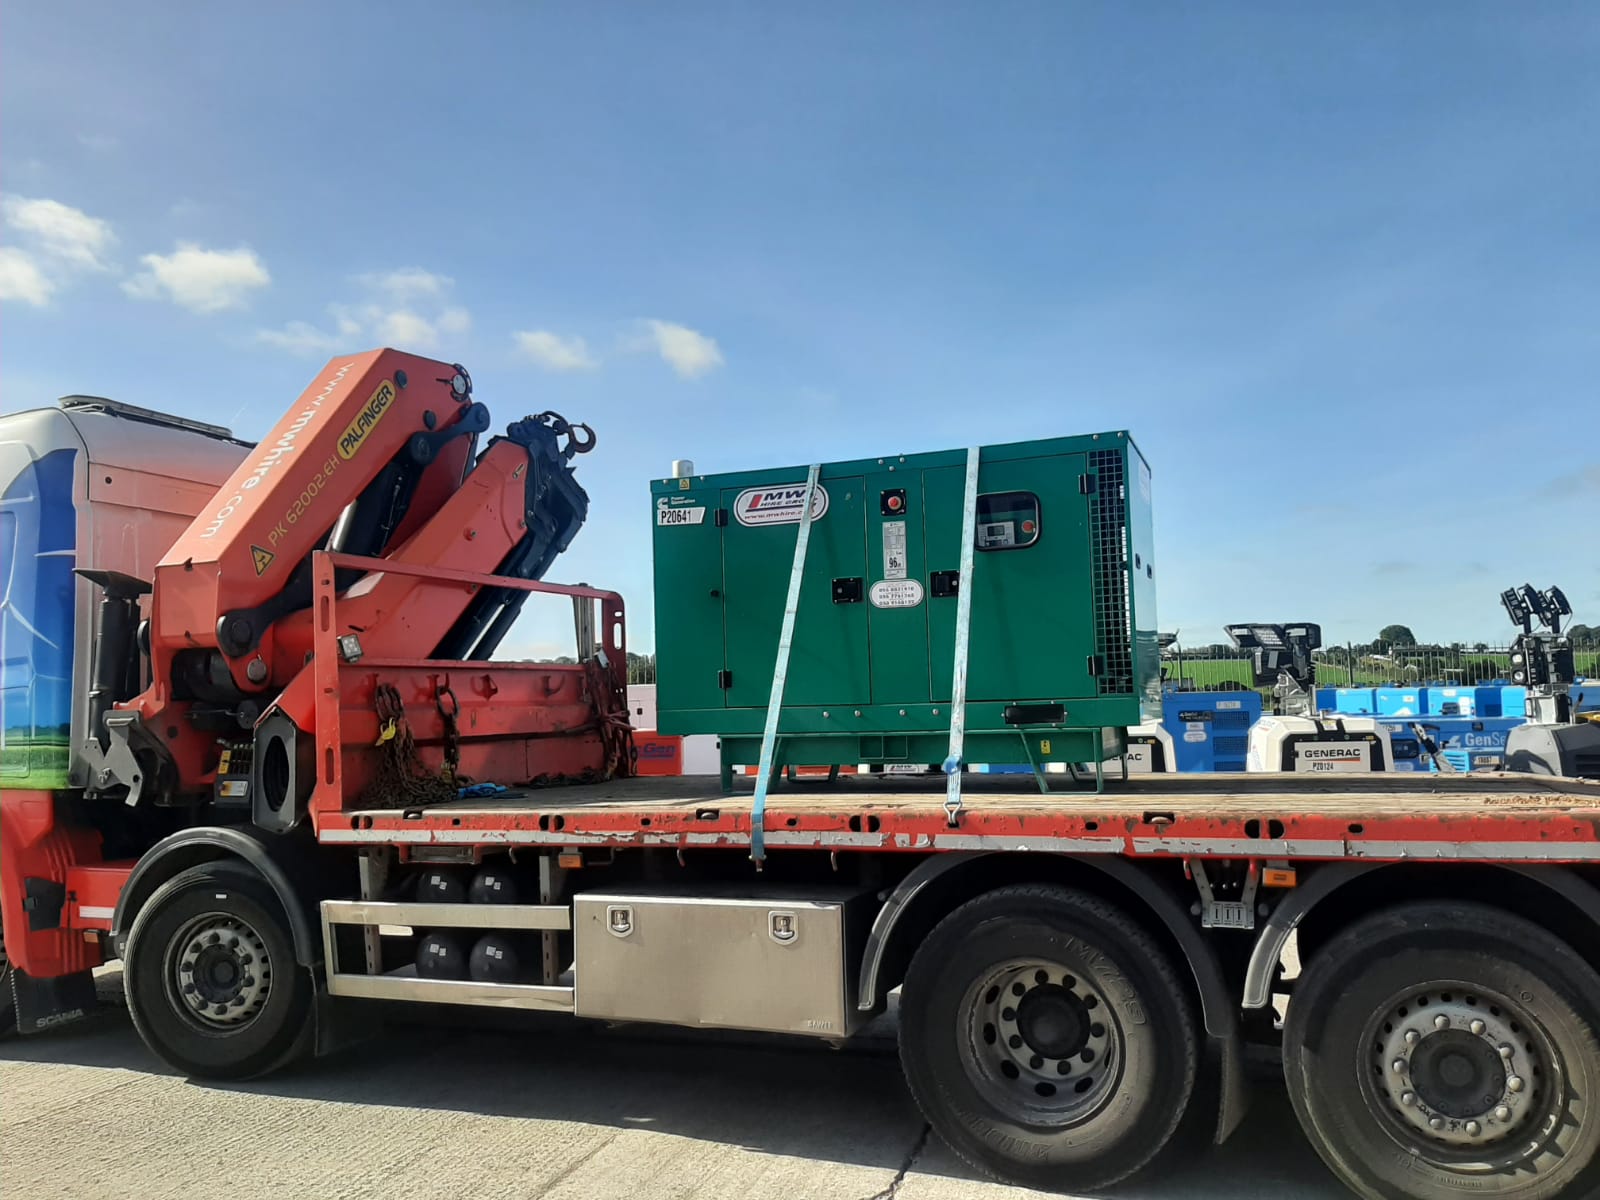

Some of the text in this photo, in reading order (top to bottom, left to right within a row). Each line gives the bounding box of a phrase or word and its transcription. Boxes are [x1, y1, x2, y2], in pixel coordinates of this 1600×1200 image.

[340, 384, 393, 456] PALFINGER
[661, 509, 692, 524] P20641
[268, 523, 289, 547] PK
[889, 557, 898, 568] 96
[1304, 748, 1361, 758] GENERAC
[36, 1008, 84, 1028] SCANIA
